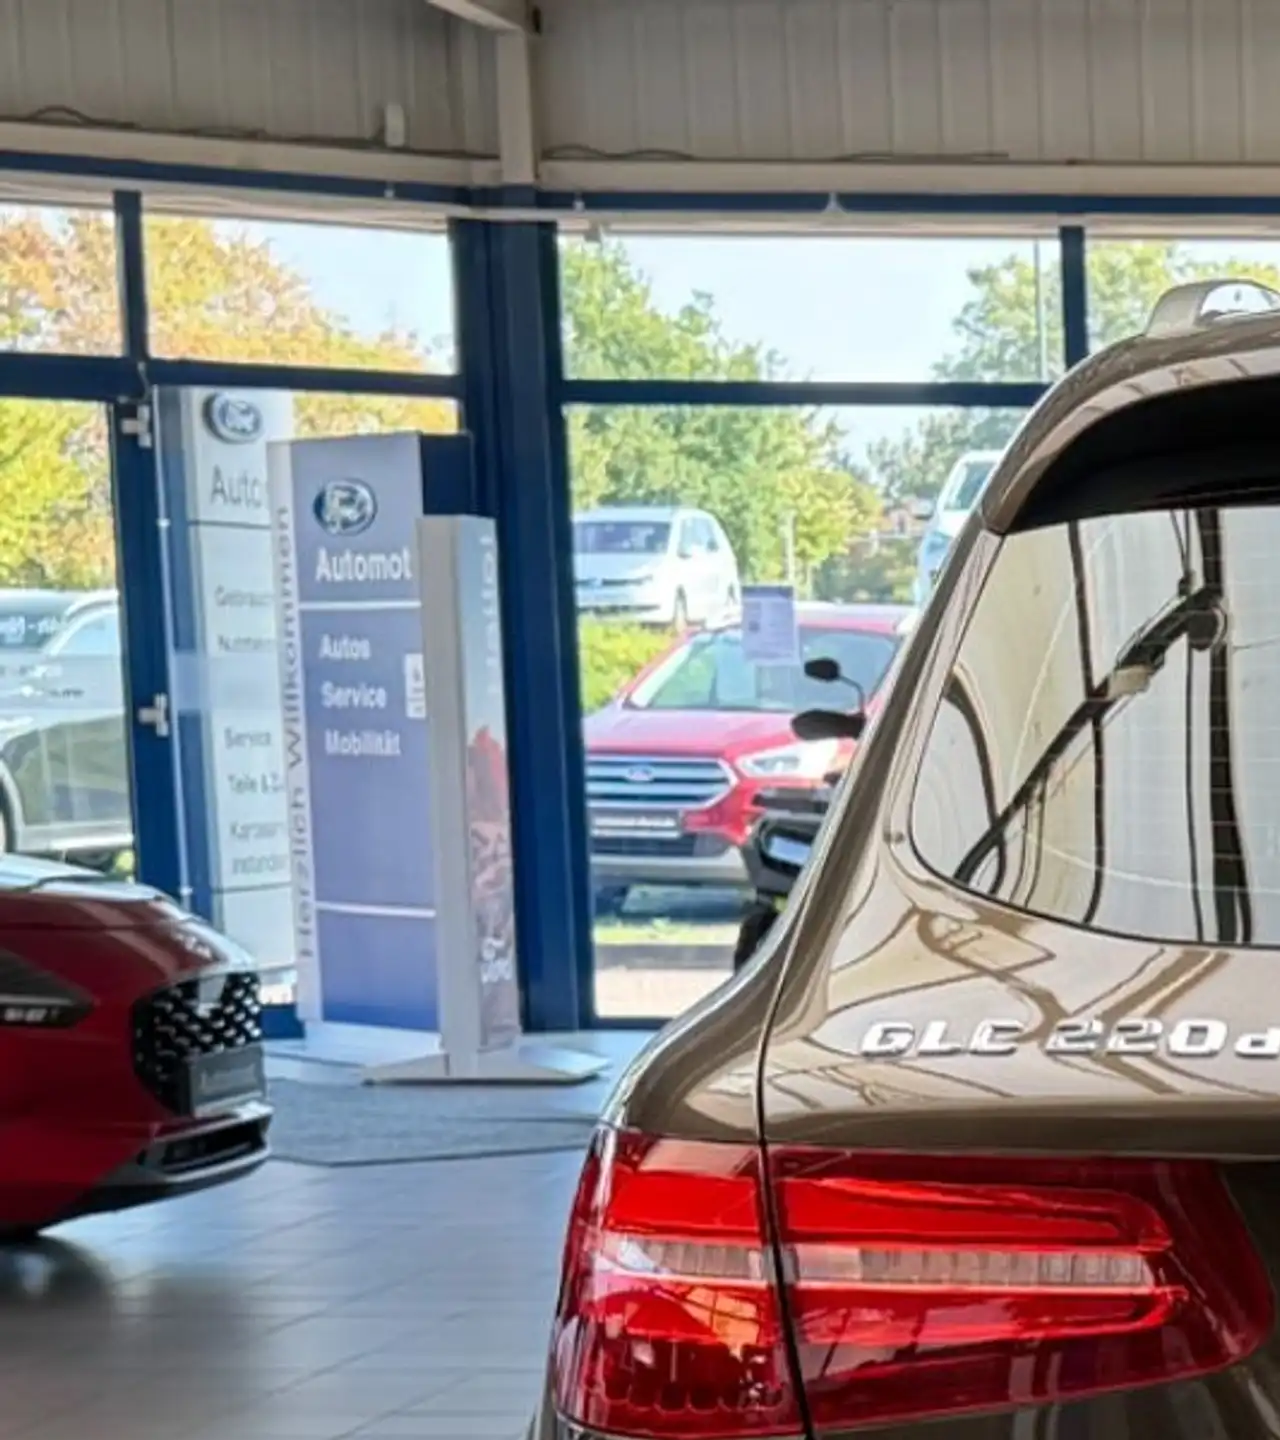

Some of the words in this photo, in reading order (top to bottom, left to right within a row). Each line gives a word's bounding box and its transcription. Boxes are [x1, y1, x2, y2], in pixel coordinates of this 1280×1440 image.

[315, 547, 413, 582] Automot
[277, 506, 302, 770] Willkommen
[319, 634, 372, 660] Autos
[321, 681, 388, 708] Service
[324, 730, 402, 757] Mobilität
[861, 1020, 1024, 1058] GLC
